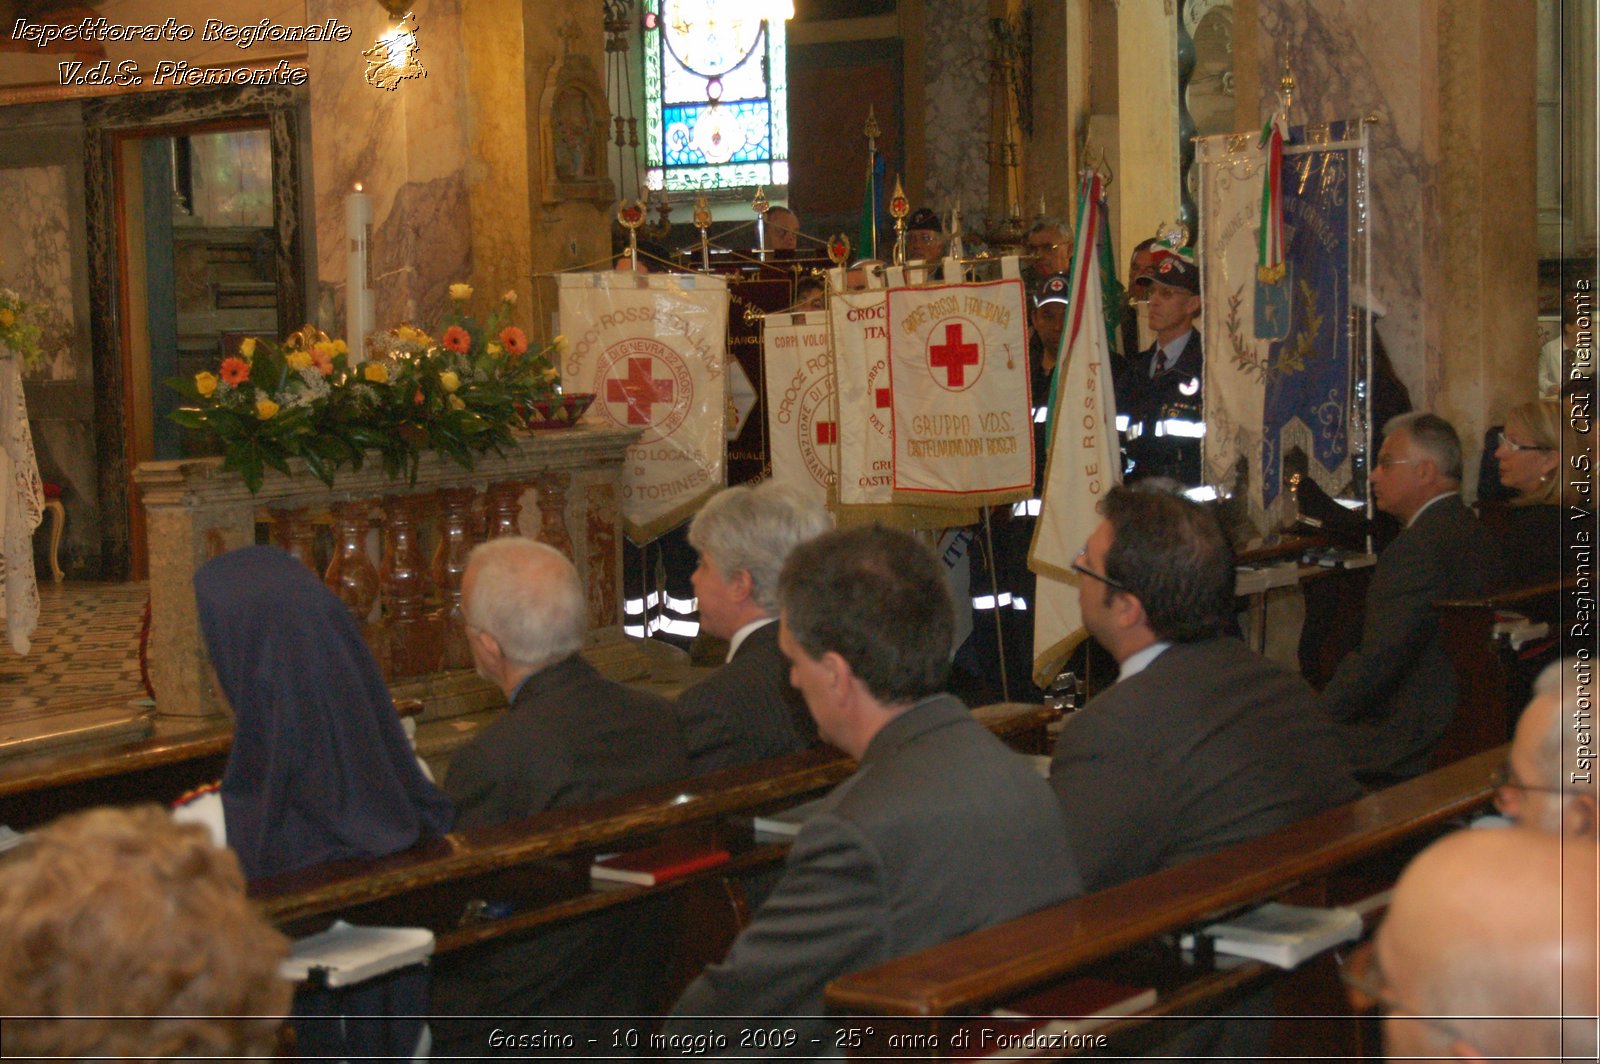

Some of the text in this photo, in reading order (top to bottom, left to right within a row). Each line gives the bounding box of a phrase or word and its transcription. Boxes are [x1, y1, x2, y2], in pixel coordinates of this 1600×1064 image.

[847, 306, 886, 323] CROC
[927, 295, 961, 320] ROSSA
[963, 295, 1011, 330] ITALIANA
[727, 336, 764, 346] SANGU
[864, 326, 888, 340] ITA
[665, 351, 679, 366] 22
[777, 366, 808, 425] CROCE
[809, 385, 823, 402] DI
[1083, 361, 1102, 449] ROSSA
[868, 412, 885, 435] DEL
[912, 413, 971, 437] GRUPPO
[978, 410, 1015, 433] V.D.S.
